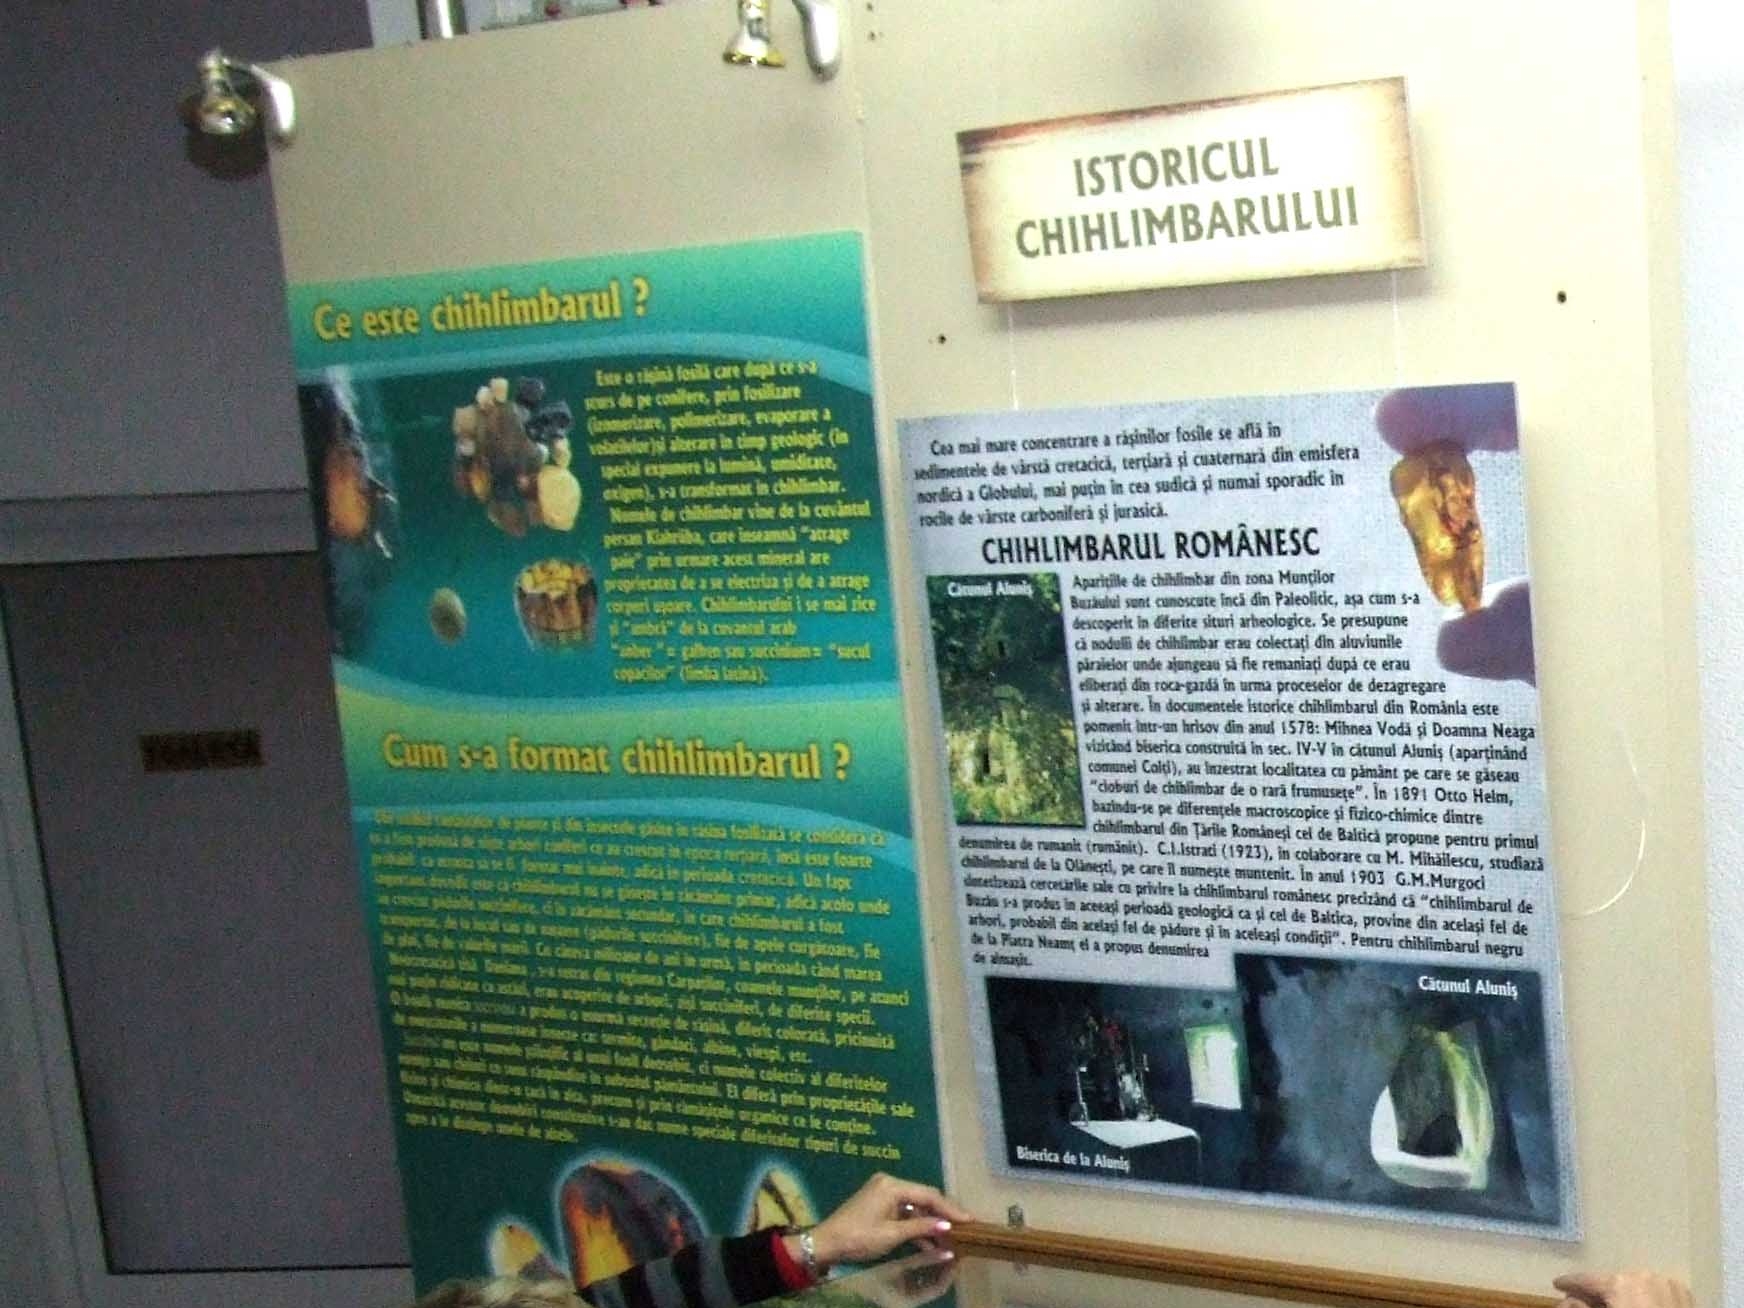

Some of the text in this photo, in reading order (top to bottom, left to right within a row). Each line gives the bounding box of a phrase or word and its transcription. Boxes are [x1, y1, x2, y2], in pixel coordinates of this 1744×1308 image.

[1073, 137, 1279, 197] ISTORICUL
[1015, 186, 1358, 258] CHIHLIMBARULUI
[314, 278, 649, 340] Ce este chihlimbarul ?
[931, 439, 954, 455] Cea
[960, 437, 981, 454] mai
[986, 440, 1017, 452] mare
[1022, 435, 1098, 451] concentrare
[1176, 426, 1212, 443] fosile
[1218, 430, 1232, 441] se
[1269, 423, 1281, 439] în
[982, 524, 1320, 564] CHIHLIMBARUL ROMÂNESC
[1240, 613, 1408, 631] arheologice. Se presupune
[1281, 721, 1319, 735] 1578:
[1325, 722, 1372, 736] Mihnea
[1433, 723, 1487, 738] Doamna
[1493, 724, 1534, 742] Neaga
[383, 733, 850, 781] Cum s-a format chihlimbarul ?
[1063, 1151, 1077, 1165] de
[1080, 1152, 1090, 1166] la
